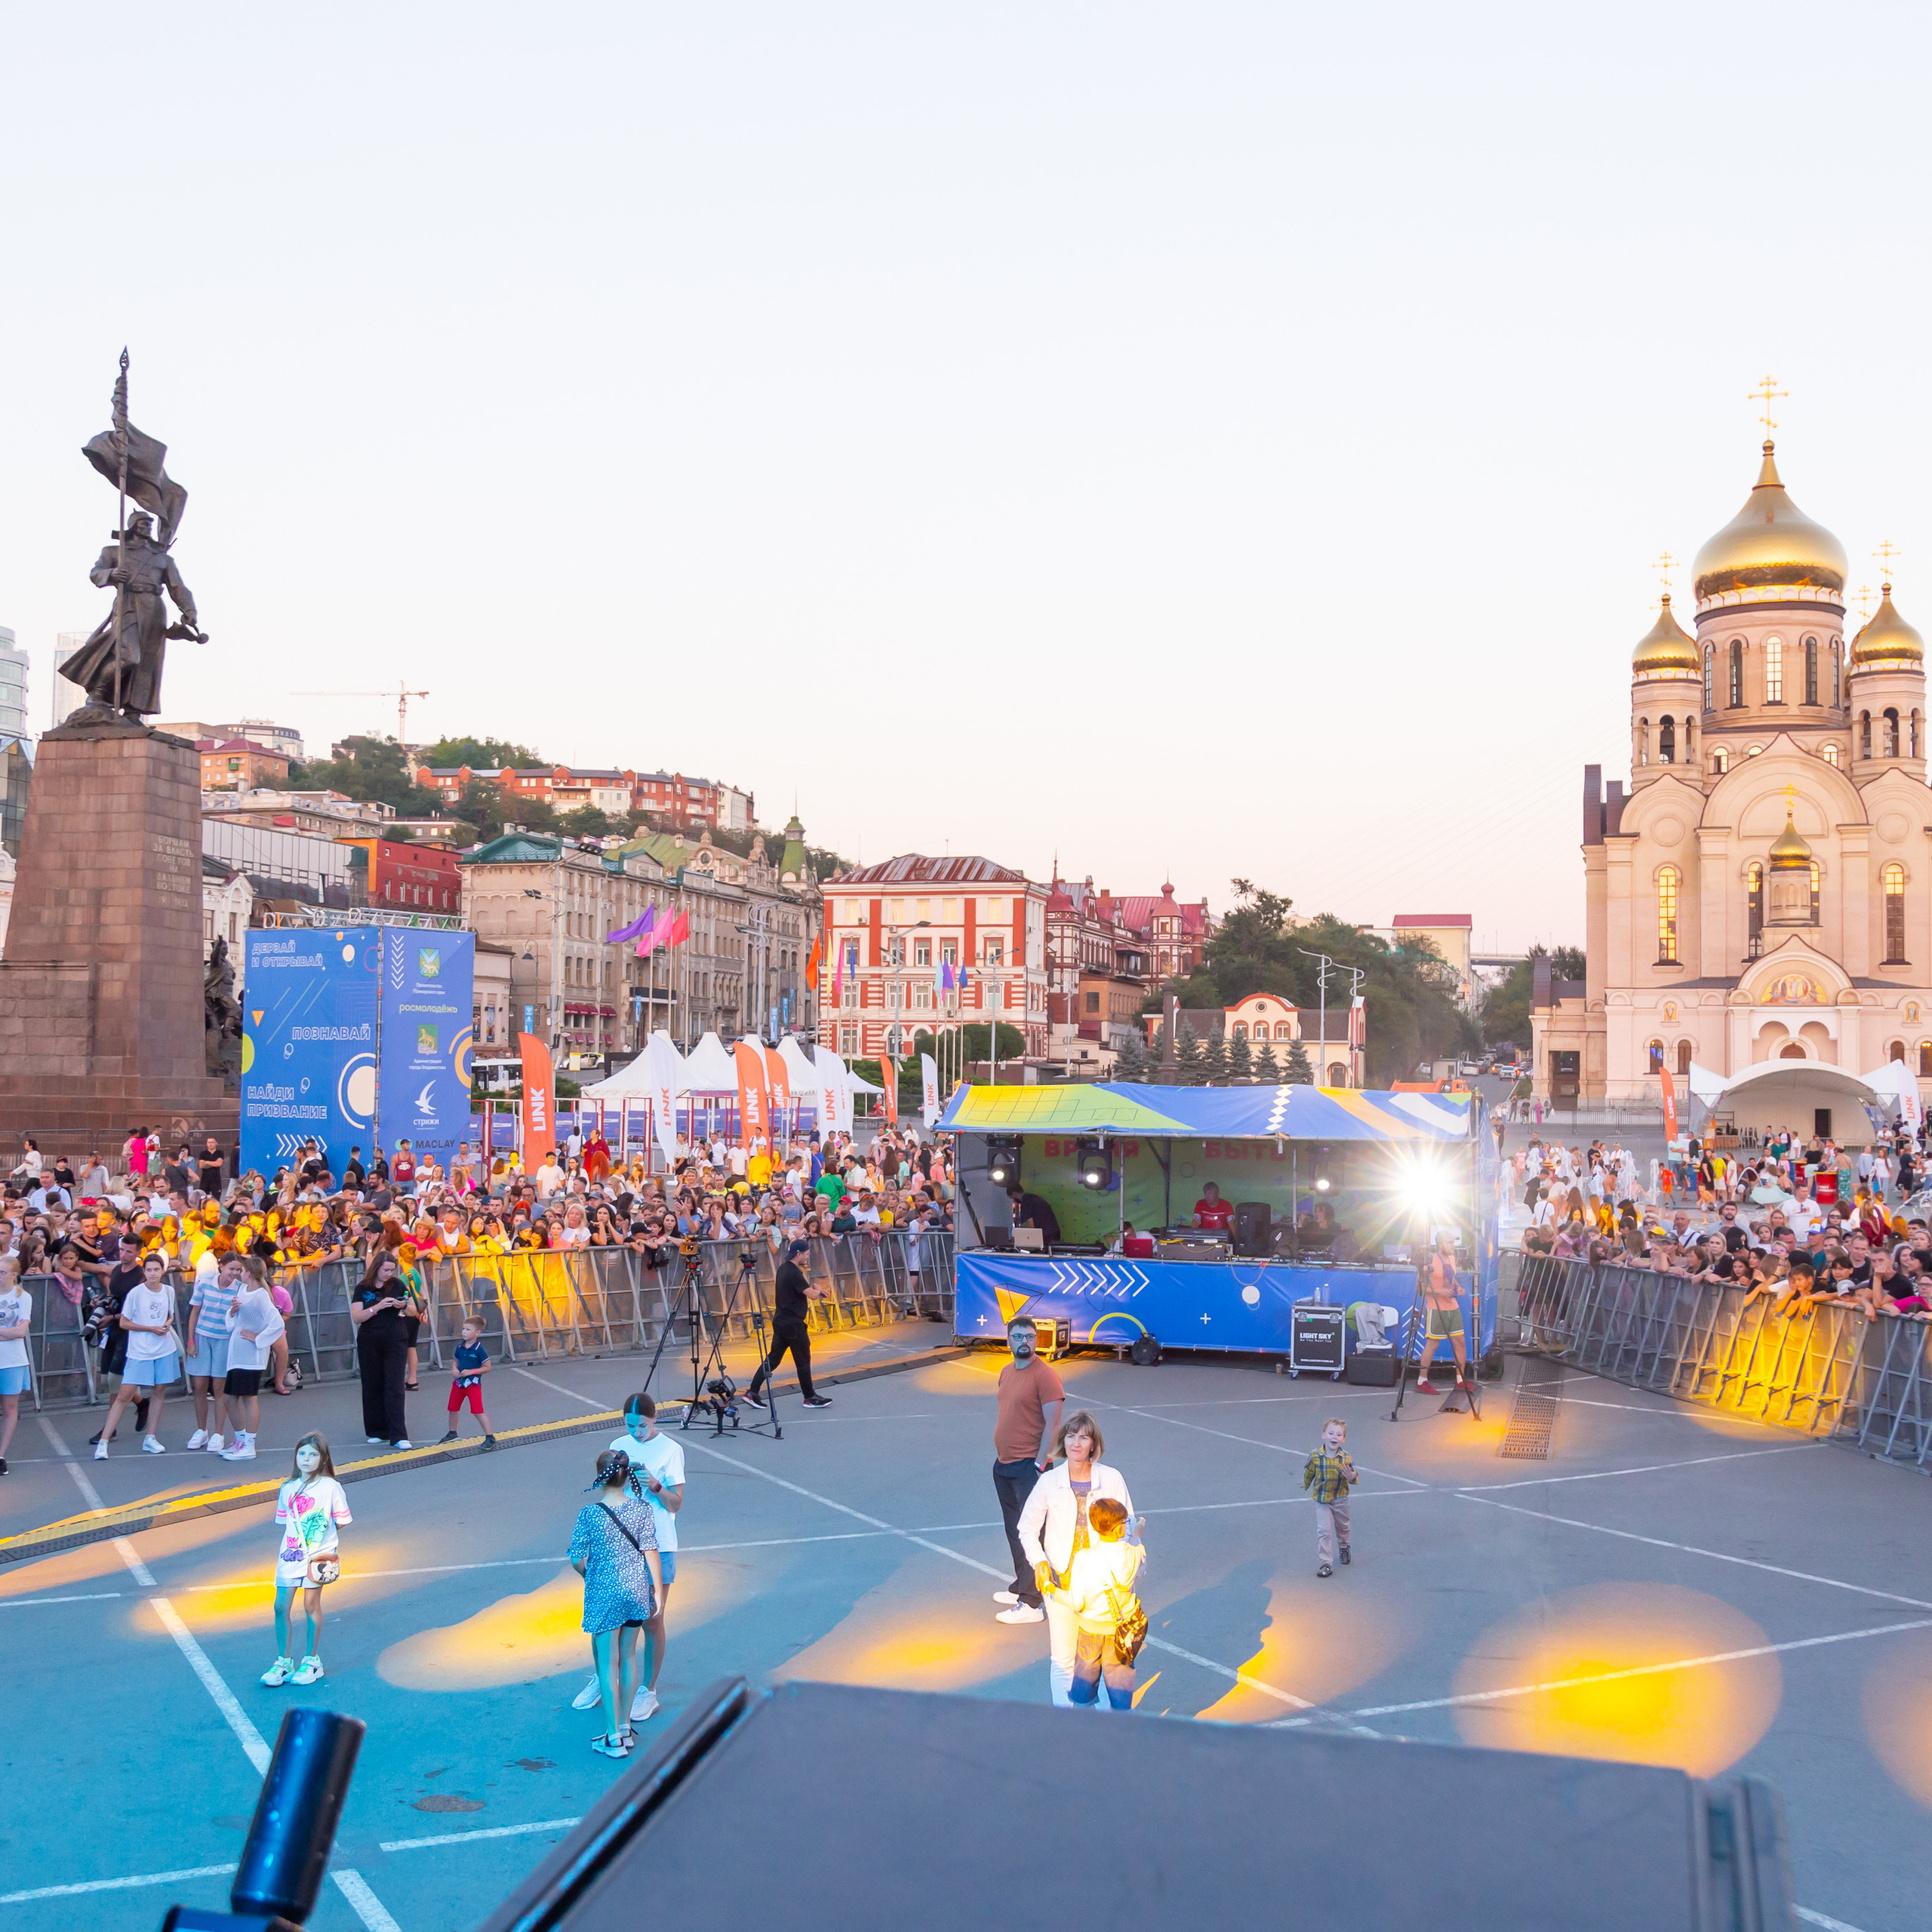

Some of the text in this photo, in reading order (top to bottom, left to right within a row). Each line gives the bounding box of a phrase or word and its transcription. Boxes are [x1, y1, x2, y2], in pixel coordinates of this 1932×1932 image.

[158, 835, 190, 848] БОРЦАМ
[153, 843, 195, 858] ЗА ВЛАСТЬ
[157, 854, 192, 867] СОВЕТОВ
[169, 864, 180, 874] НА
[251, 940, 297, 955] ДЕРЗАЙ
[251, 952, 324, 968] И ОТКРЫВАЙ
[292, 1023, 371, 1041] ПОЗНАВАЙ
[248, 1083, 295, 1103] НАЙДИ
[247, 1103, 328, 1119] ПРИЗВАНИЕ
[413, 1118, 440, 1127] стрижи
[415, 1139, 456, 1149] MACLAY
[1044, 1140, 1287, 1161] ВРЯ БЫТЬ
